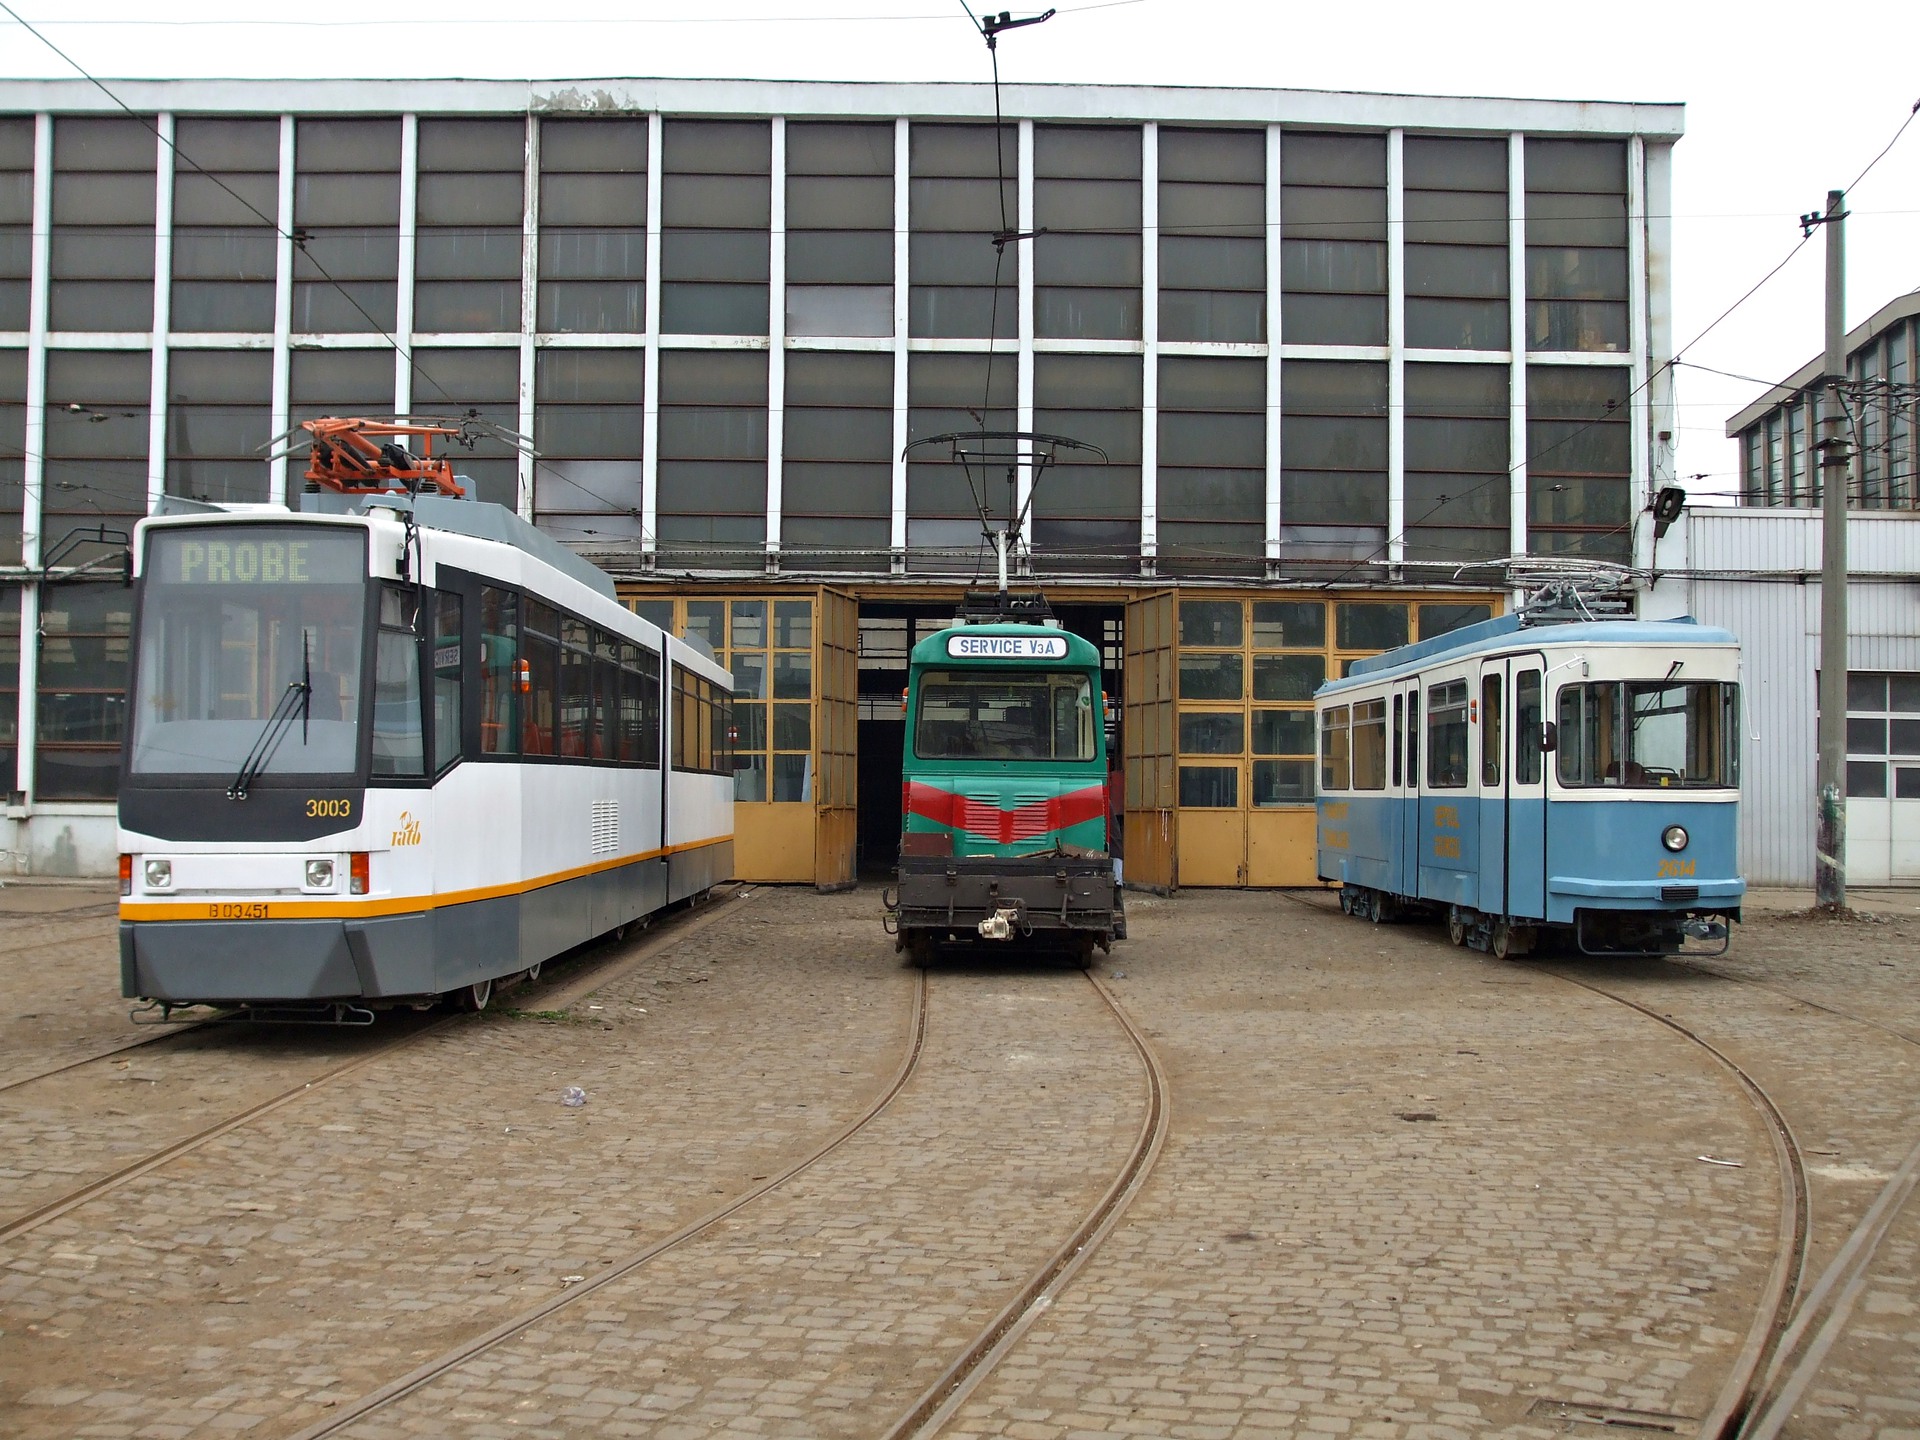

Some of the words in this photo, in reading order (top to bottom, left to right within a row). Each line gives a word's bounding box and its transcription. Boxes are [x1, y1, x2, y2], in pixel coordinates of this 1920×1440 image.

[181, 542, 310, 582] PROBE
[960, 639, 1022, 654] SERVICE
[306, 799, 351, 817] 3003
[1657, 858, 1696, 878] 2614
[209, 904, 219, 918] B
[223, 904, 269, 918] 03451
